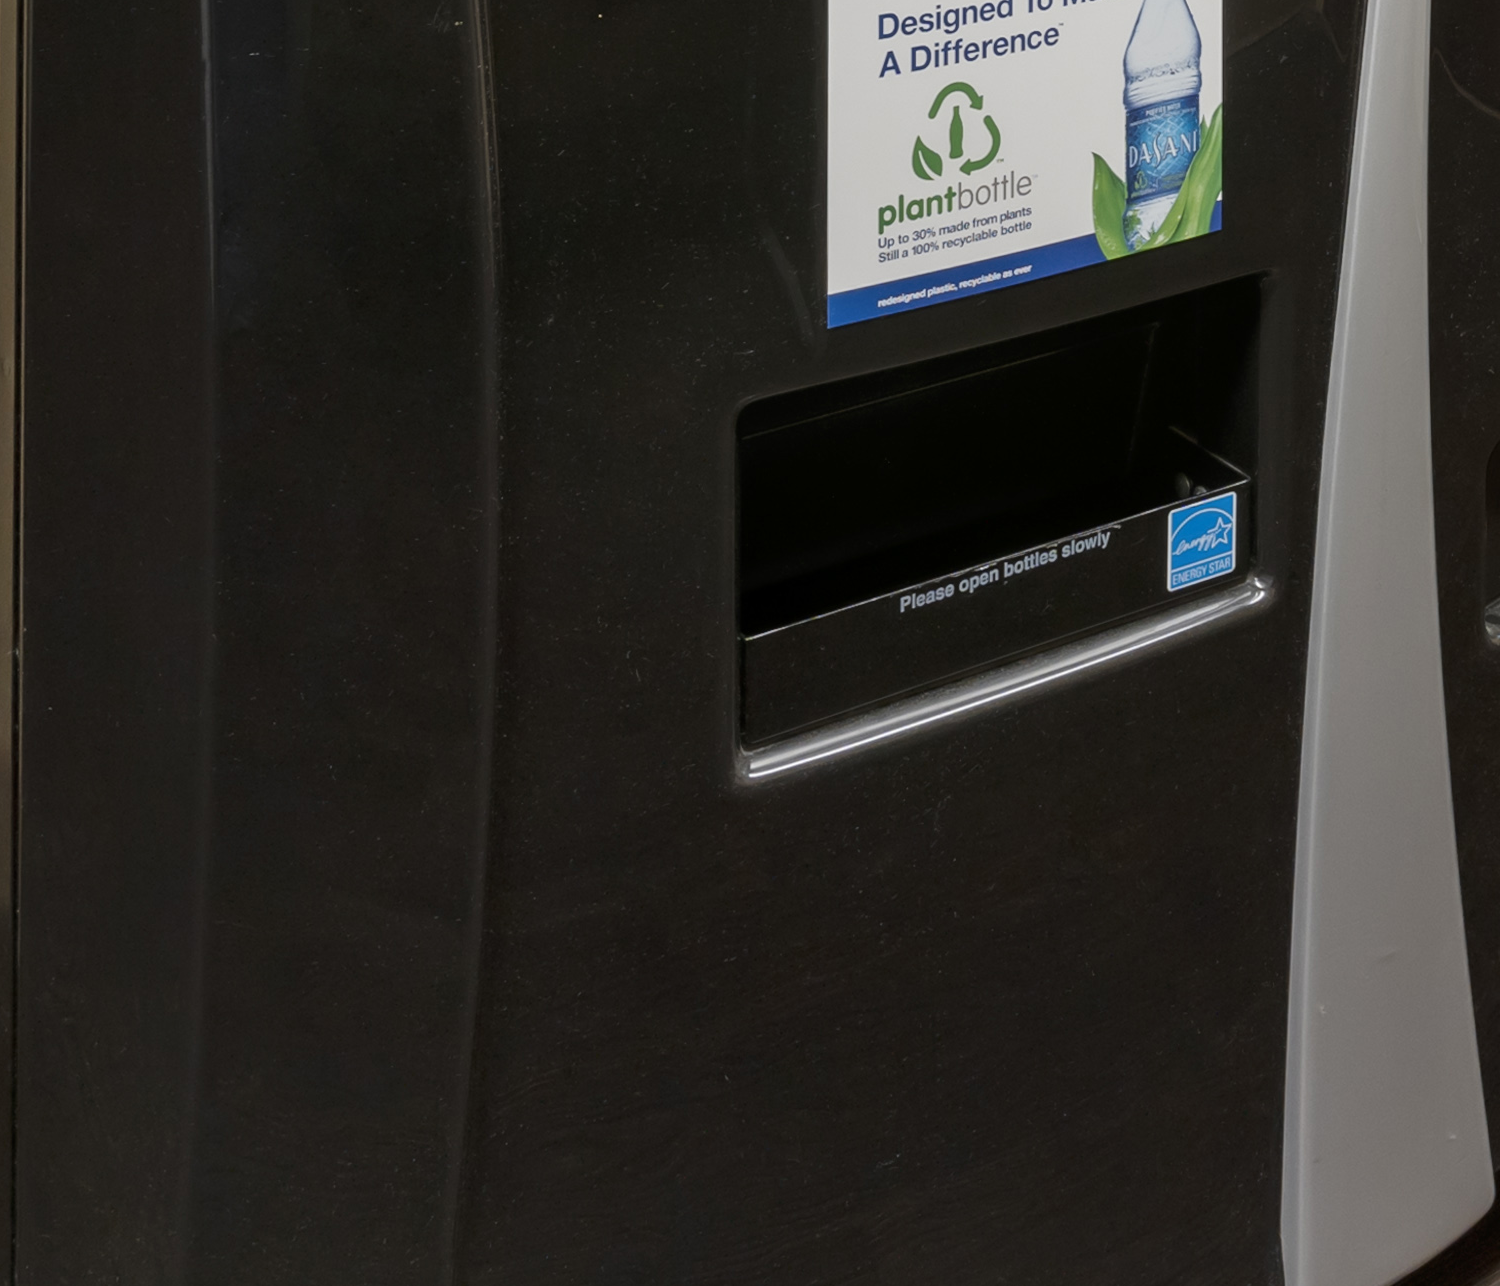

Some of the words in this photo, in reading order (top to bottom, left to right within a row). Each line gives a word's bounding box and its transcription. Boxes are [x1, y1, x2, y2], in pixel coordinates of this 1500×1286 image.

[878, 50, 902, 79] A
[910, 26, 1060, 72] Difference
[1128, 130, 1198, 170] DASANI
[878, 170, 1033, 236] plantbottle
[877, 236, 895, 250] Up
[898, 233, 910, 246] to
[912, 228, 937, 243] 30%
[938, 219, 971, 236] made
[972, 214, 999, 230] from
[999, 206, 1033, 225] plants
[877, 246, 900, 264] Still
[901, 249, 909, 259] a
[911, 240, 940, 256] 100%
[941, 228, 999, 250] recyclable
[1000, 219, 1033, 237] bottle
[877, 287, 927, 308] redesigned
[927, 281, 959, 299] plastic,
[958, 270, 1002, 291] recyclable
[1002, 269, 1013, 279] as
[1013, 263, 1034, 276] ever
[900, 582, 955, 612] Please
[959, 566, 1000, 595] open
[1002, 549, 1058, 579] bottles
[1060, 530, 1112, 560] slowly
[1172, 566, 1207, 587] ENERGY
[1208, 556, 1232, 576] STAR
